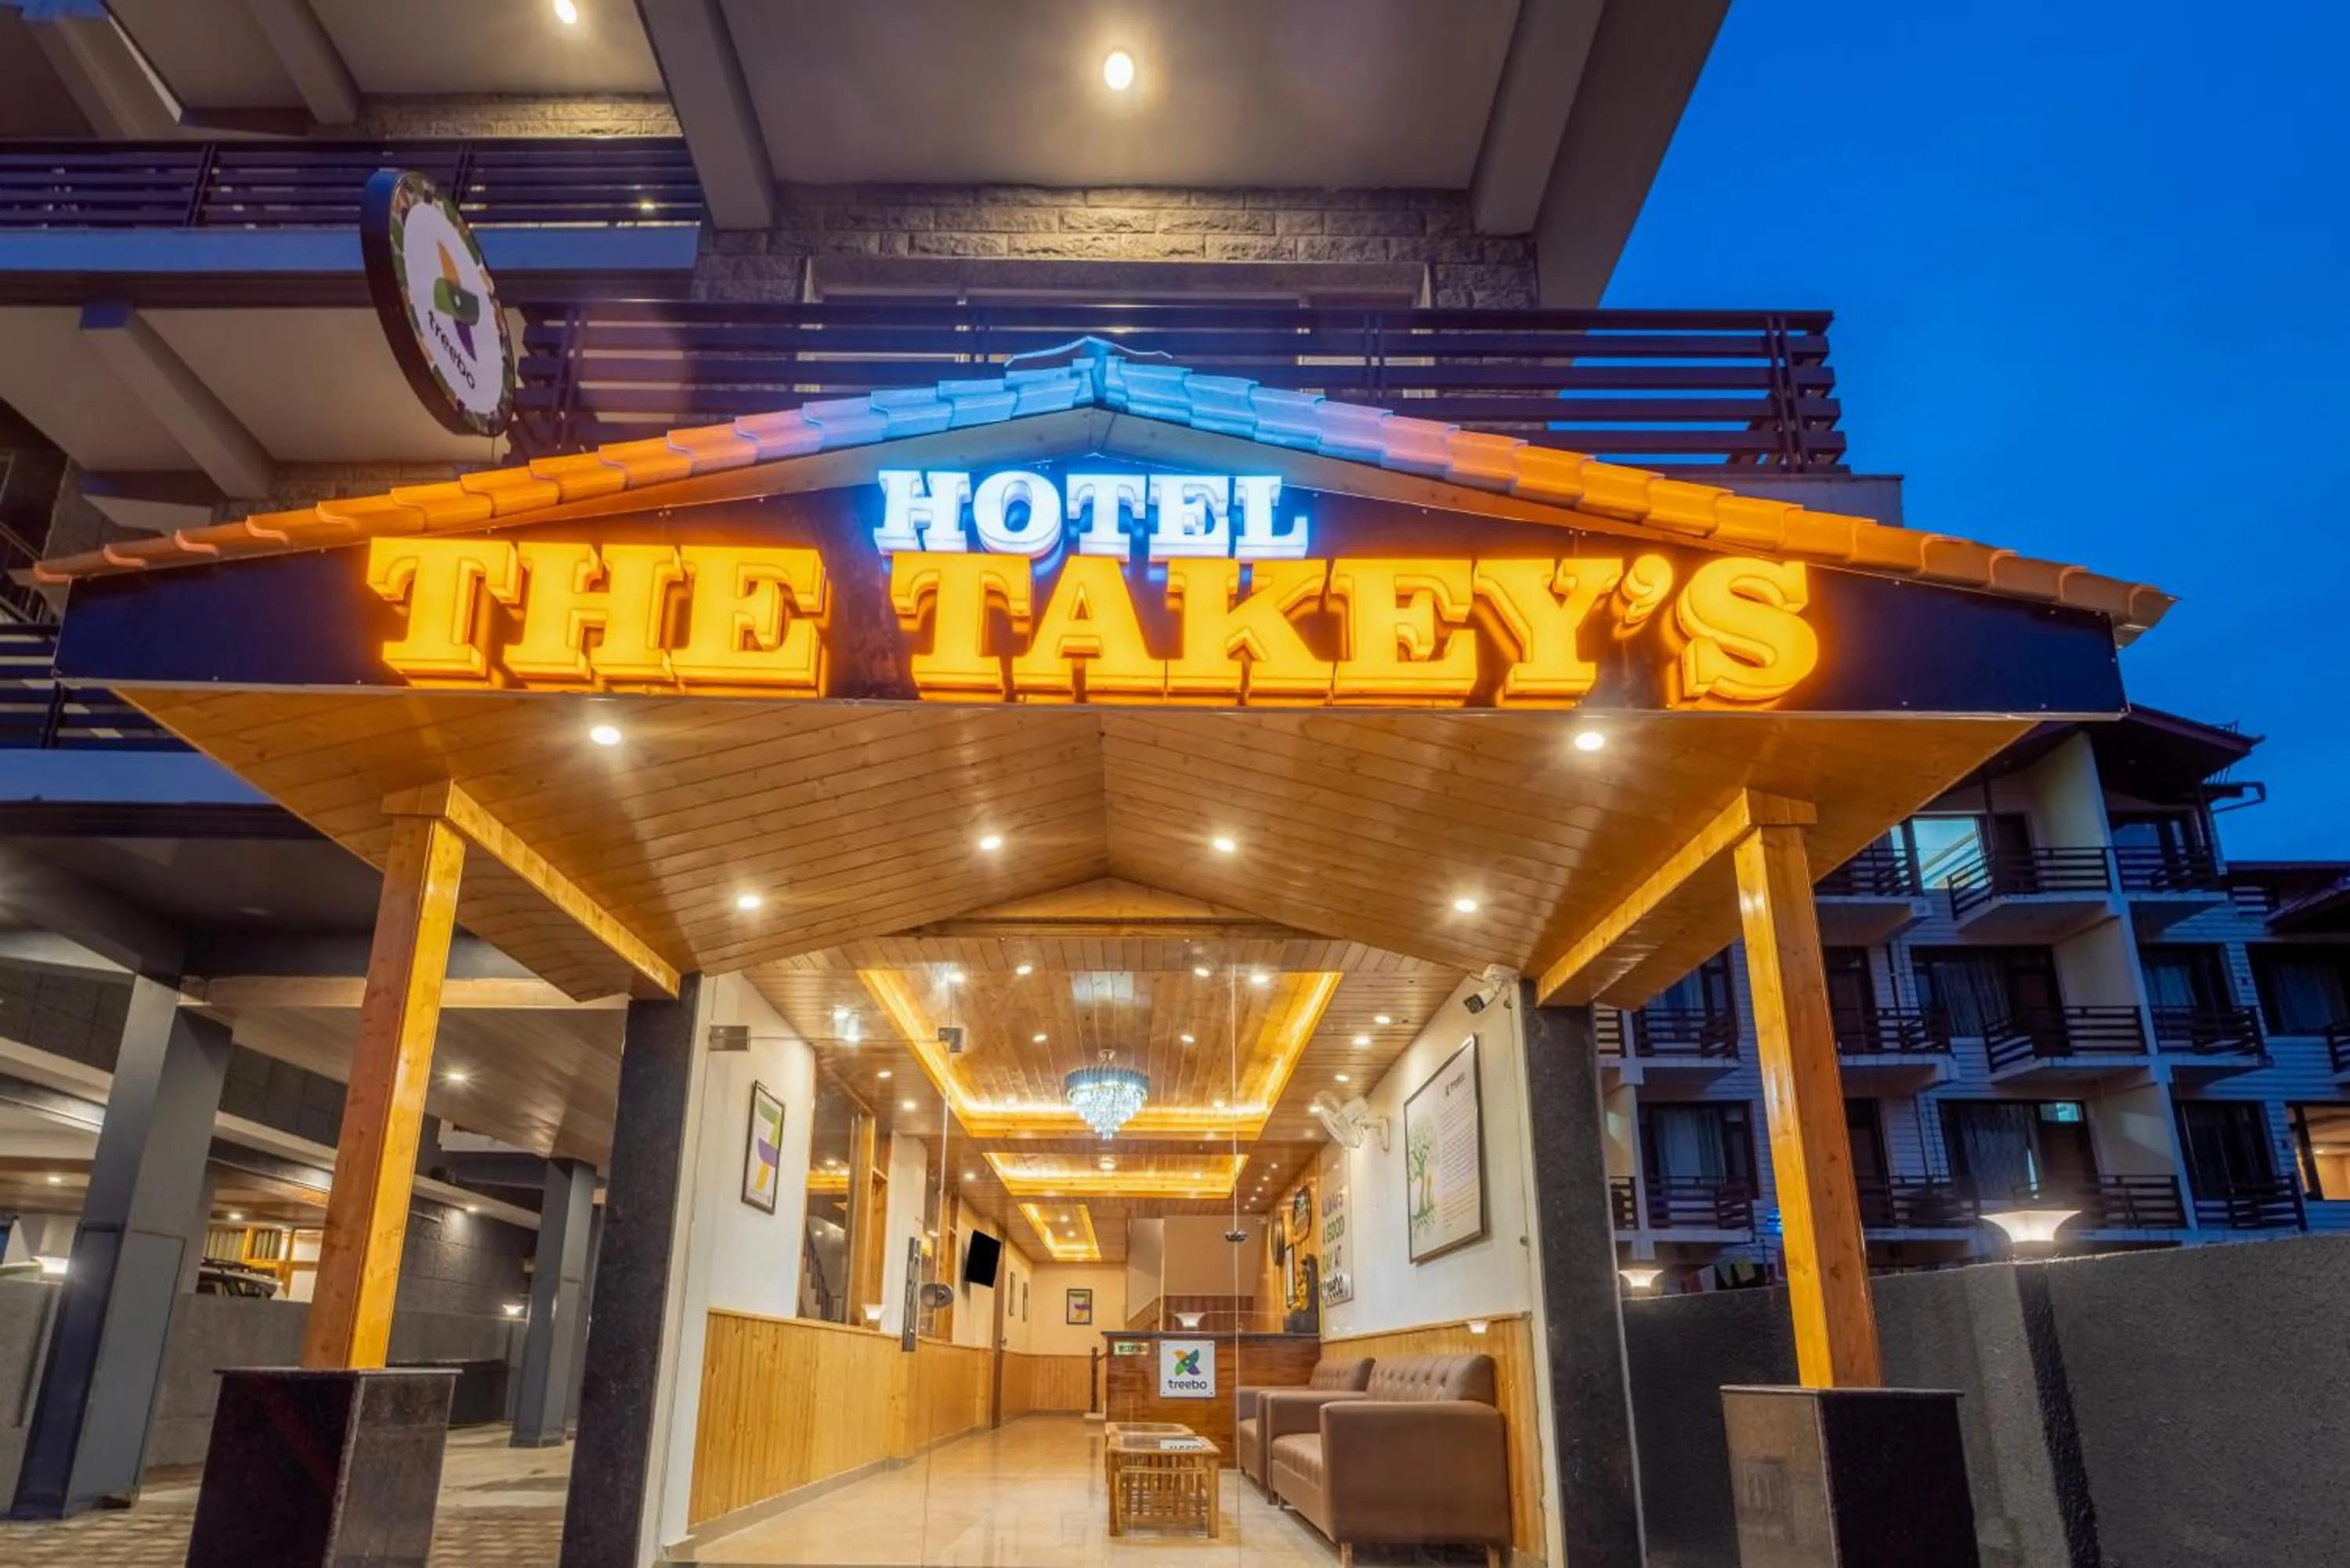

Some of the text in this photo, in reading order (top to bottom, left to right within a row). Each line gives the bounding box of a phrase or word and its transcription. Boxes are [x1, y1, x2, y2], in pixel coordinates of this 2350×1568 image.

[428, 309, 476, 390] treebo
[873, 469, 1309, 561] HOTEL
[367, 537, 1819, 703] THE TAKEY'S
[1327, 1215, 1346, 1243] GOOD
[1167, 1378, 1208, 1390] treebo
